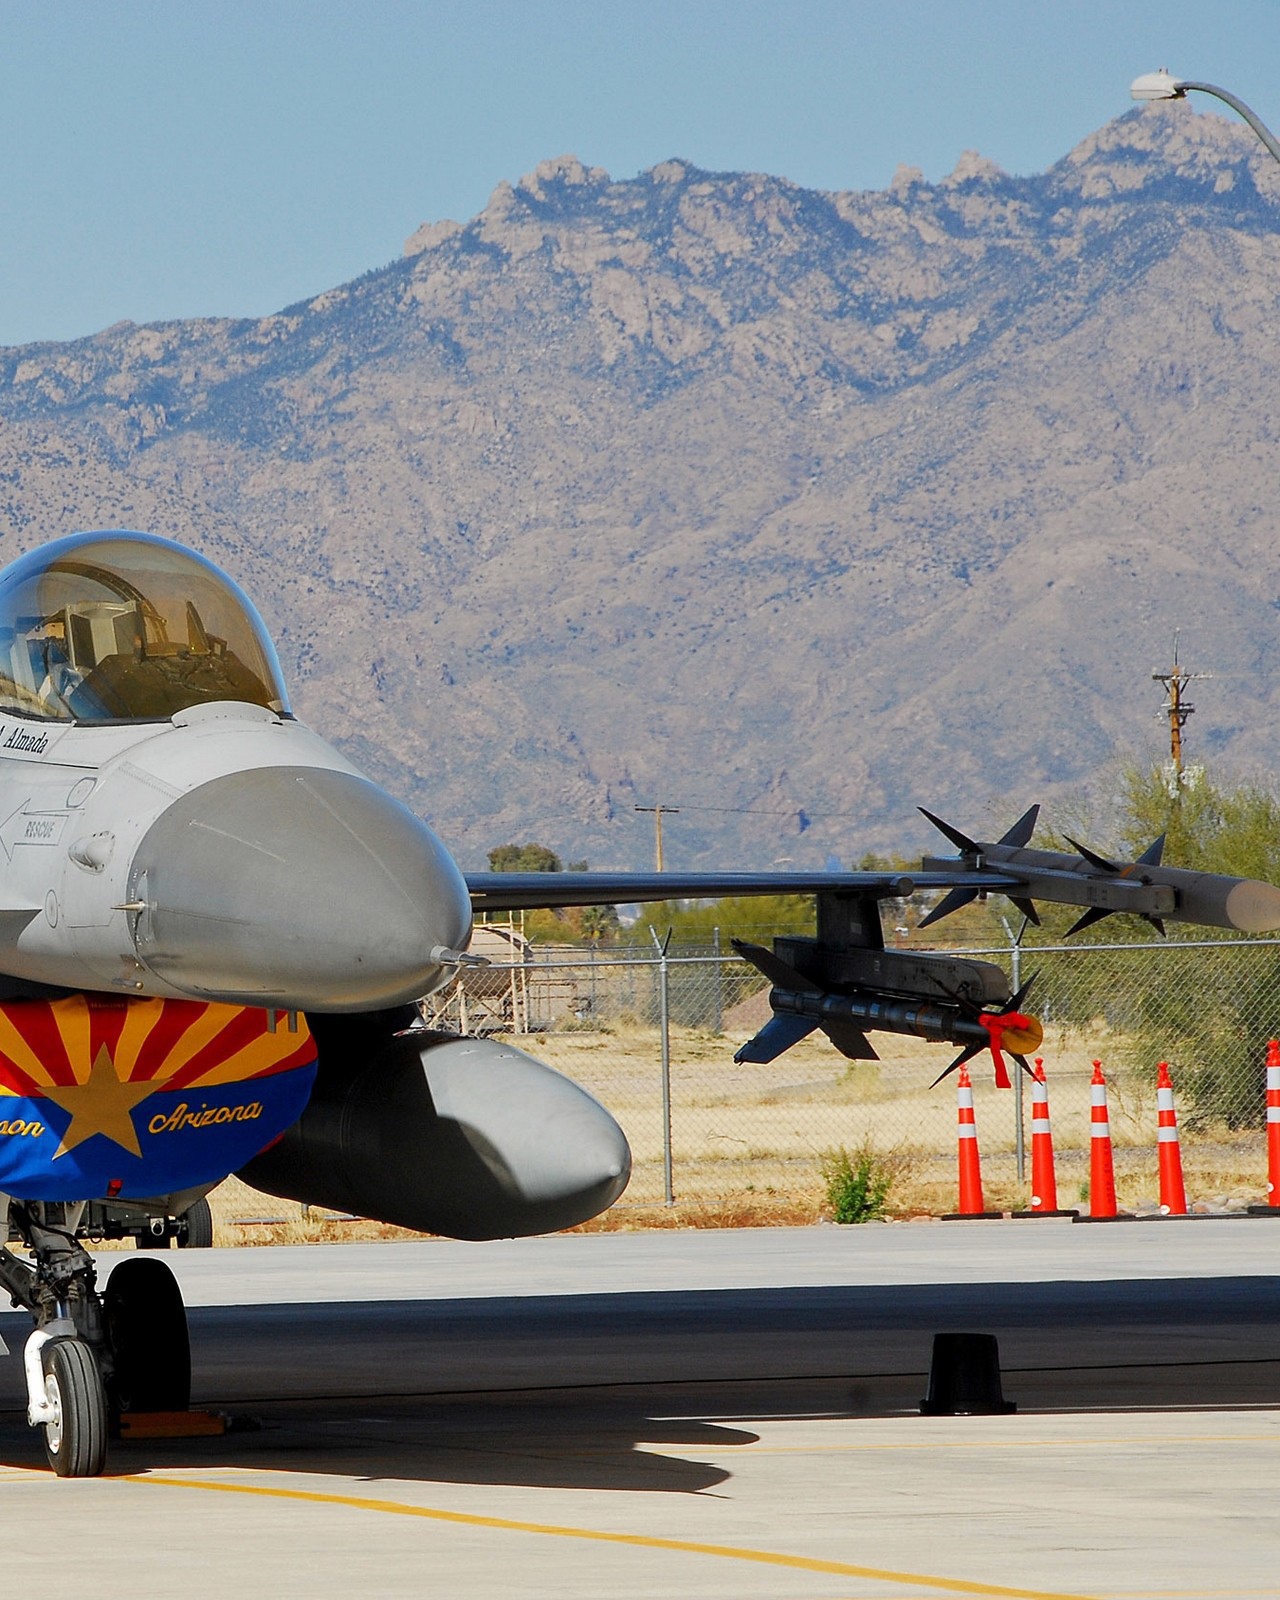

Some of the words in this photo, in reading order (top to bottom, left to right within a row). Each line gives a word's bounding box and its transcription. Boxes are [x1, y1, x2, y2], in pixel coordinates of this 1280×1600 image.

[4, 727, 48, 754] Almada
[25, 821, 55, 837] RESCUE
[148, 1102, 263, 1134] Arizona
